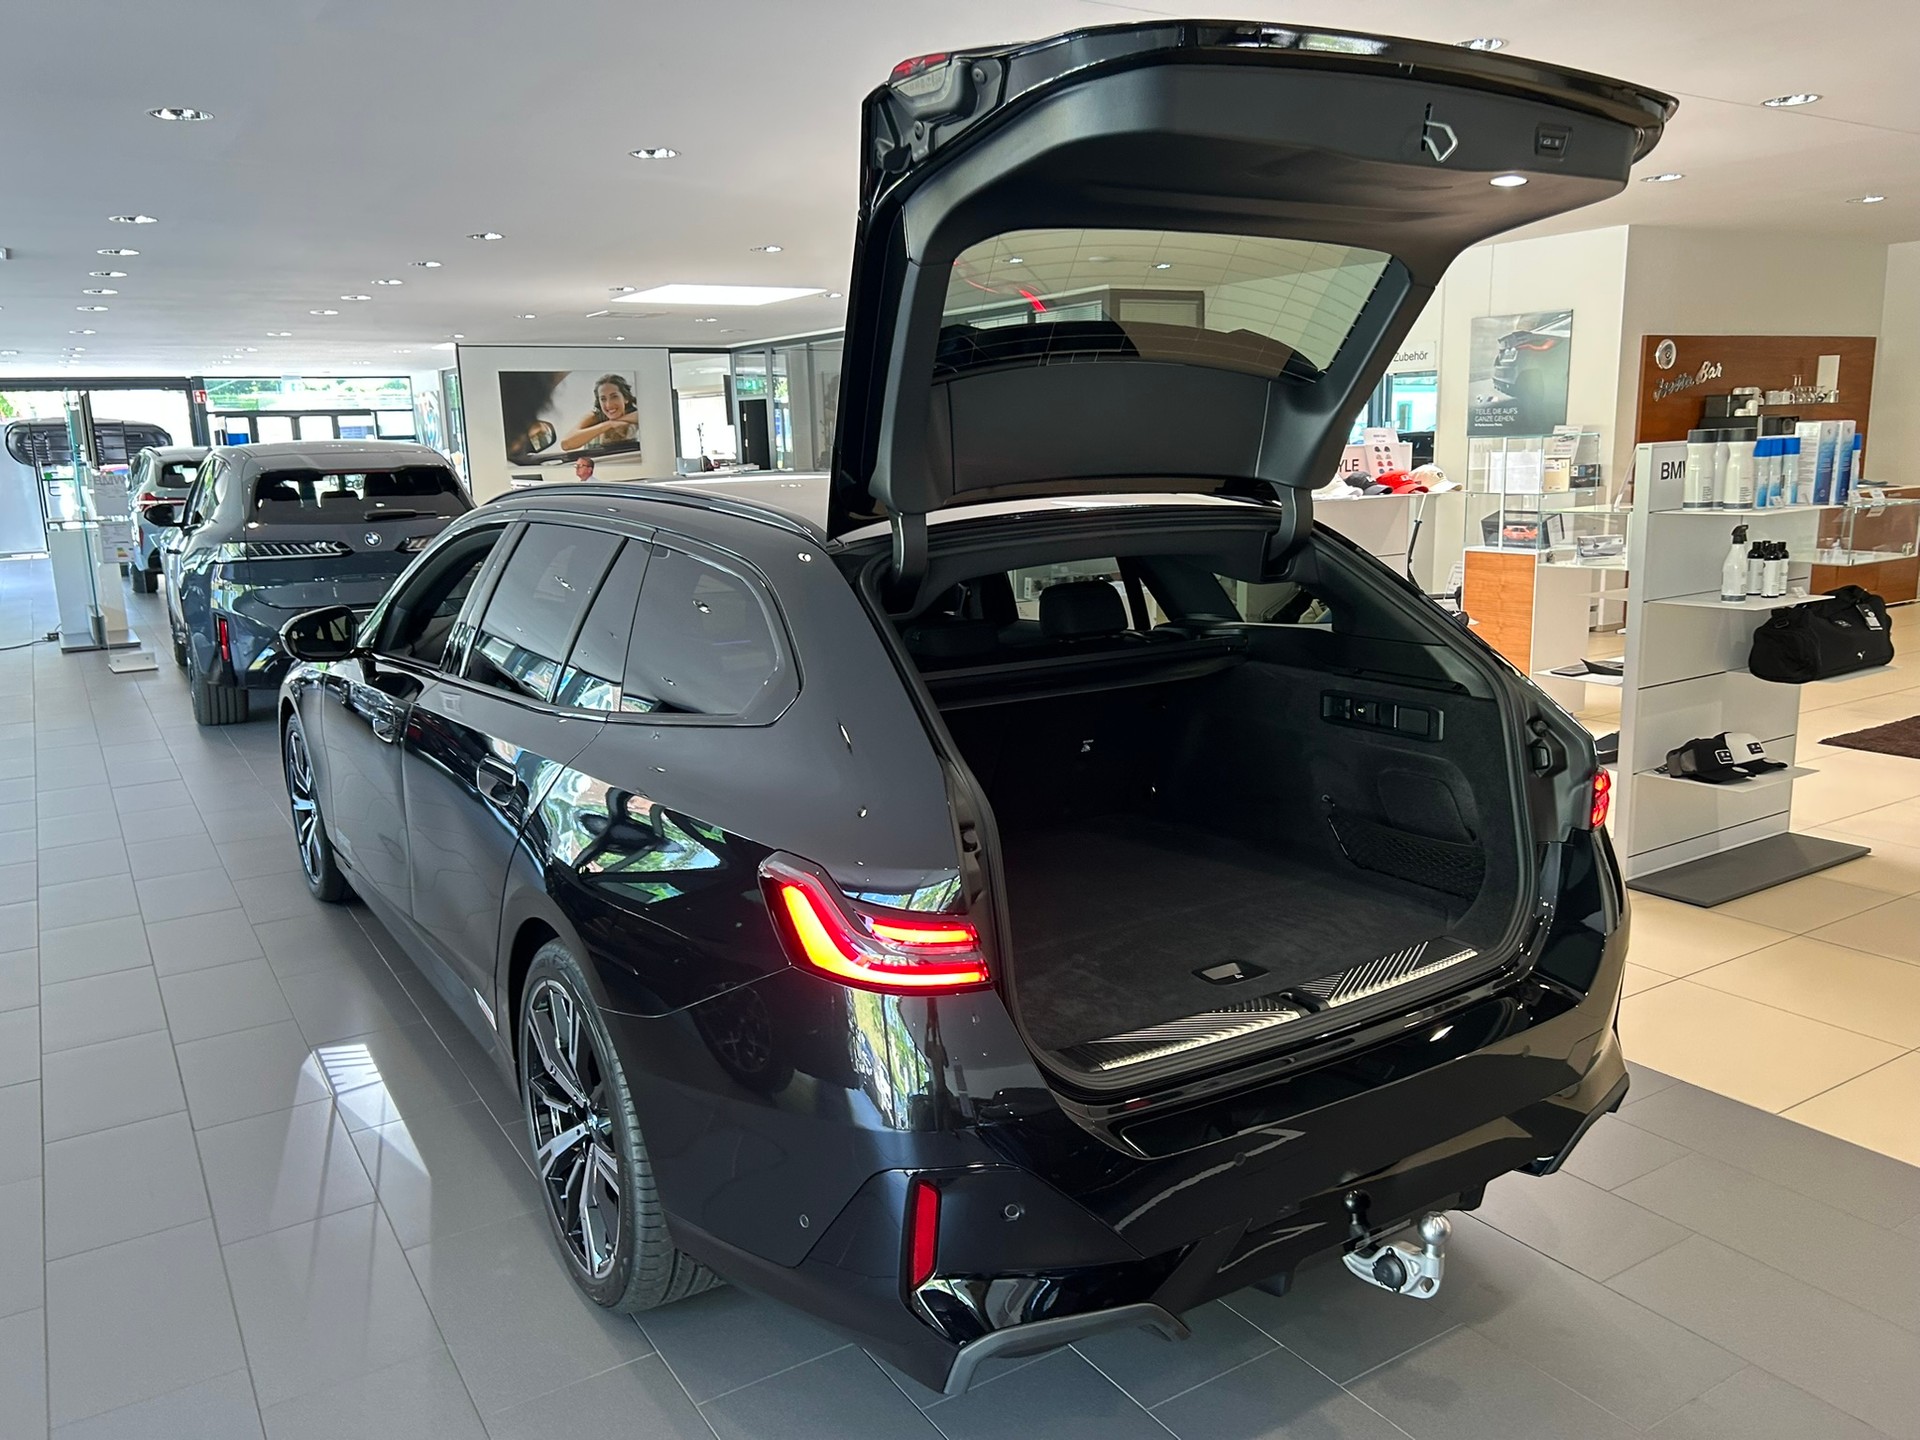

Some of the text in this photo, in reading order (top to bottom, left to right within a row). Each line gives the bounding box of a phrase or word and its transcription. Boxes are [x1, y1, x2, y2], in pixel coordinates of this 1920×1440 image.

[1393, 351, 1429, 362] Zubehör
[1695, 360, 1723, 385] Bar
[94, 475, 127, 486] BMW
